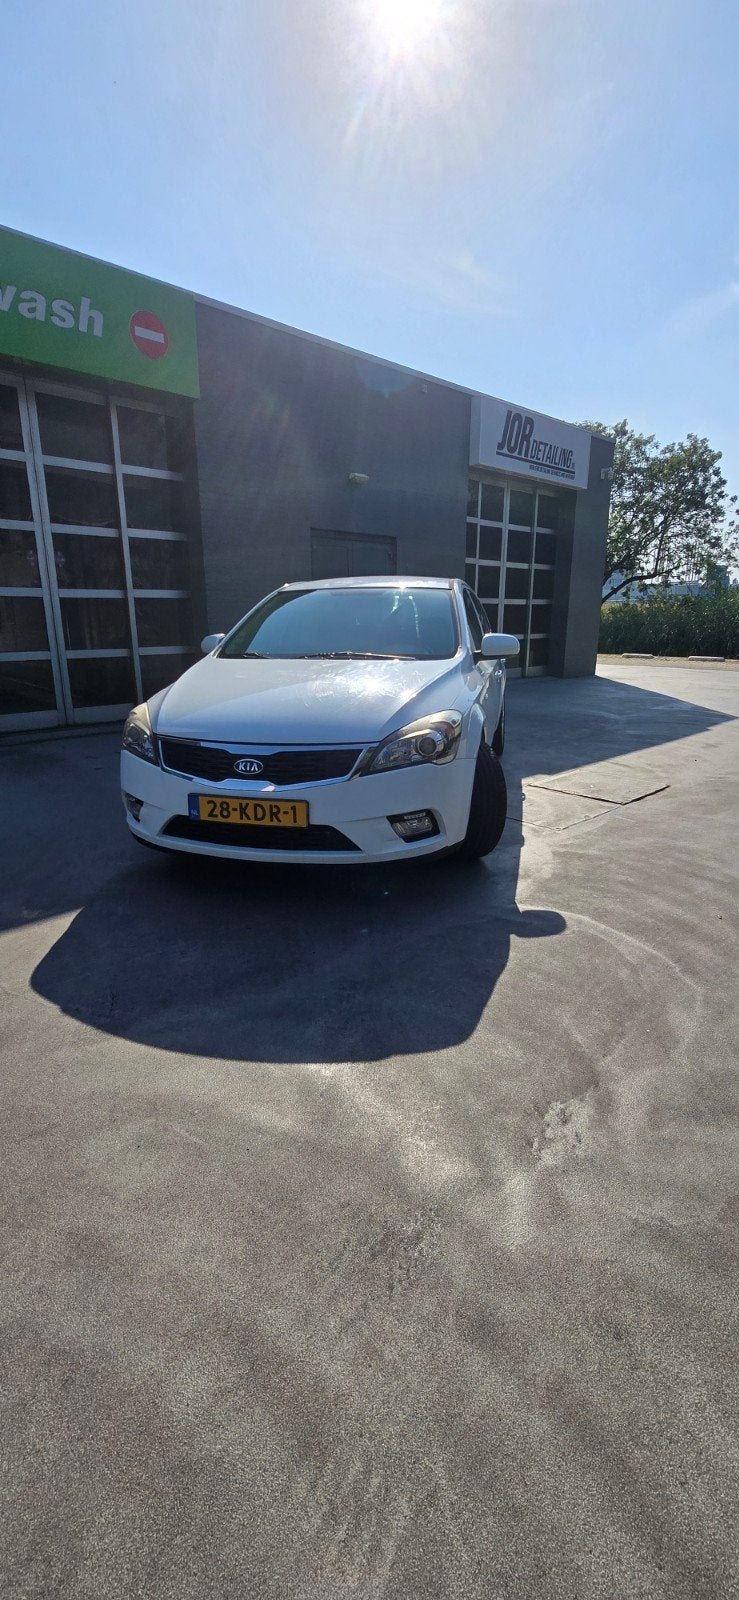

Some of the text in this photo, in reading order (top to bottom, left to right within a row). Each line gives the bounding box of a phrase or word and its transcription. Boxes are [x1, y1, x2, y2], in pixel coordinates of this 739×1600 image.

[497, 410, 573, 468] JOR DETAILING
[238, 762, 259, 772] KIA
[207, 800, 298, 823] 28-KDR-1
